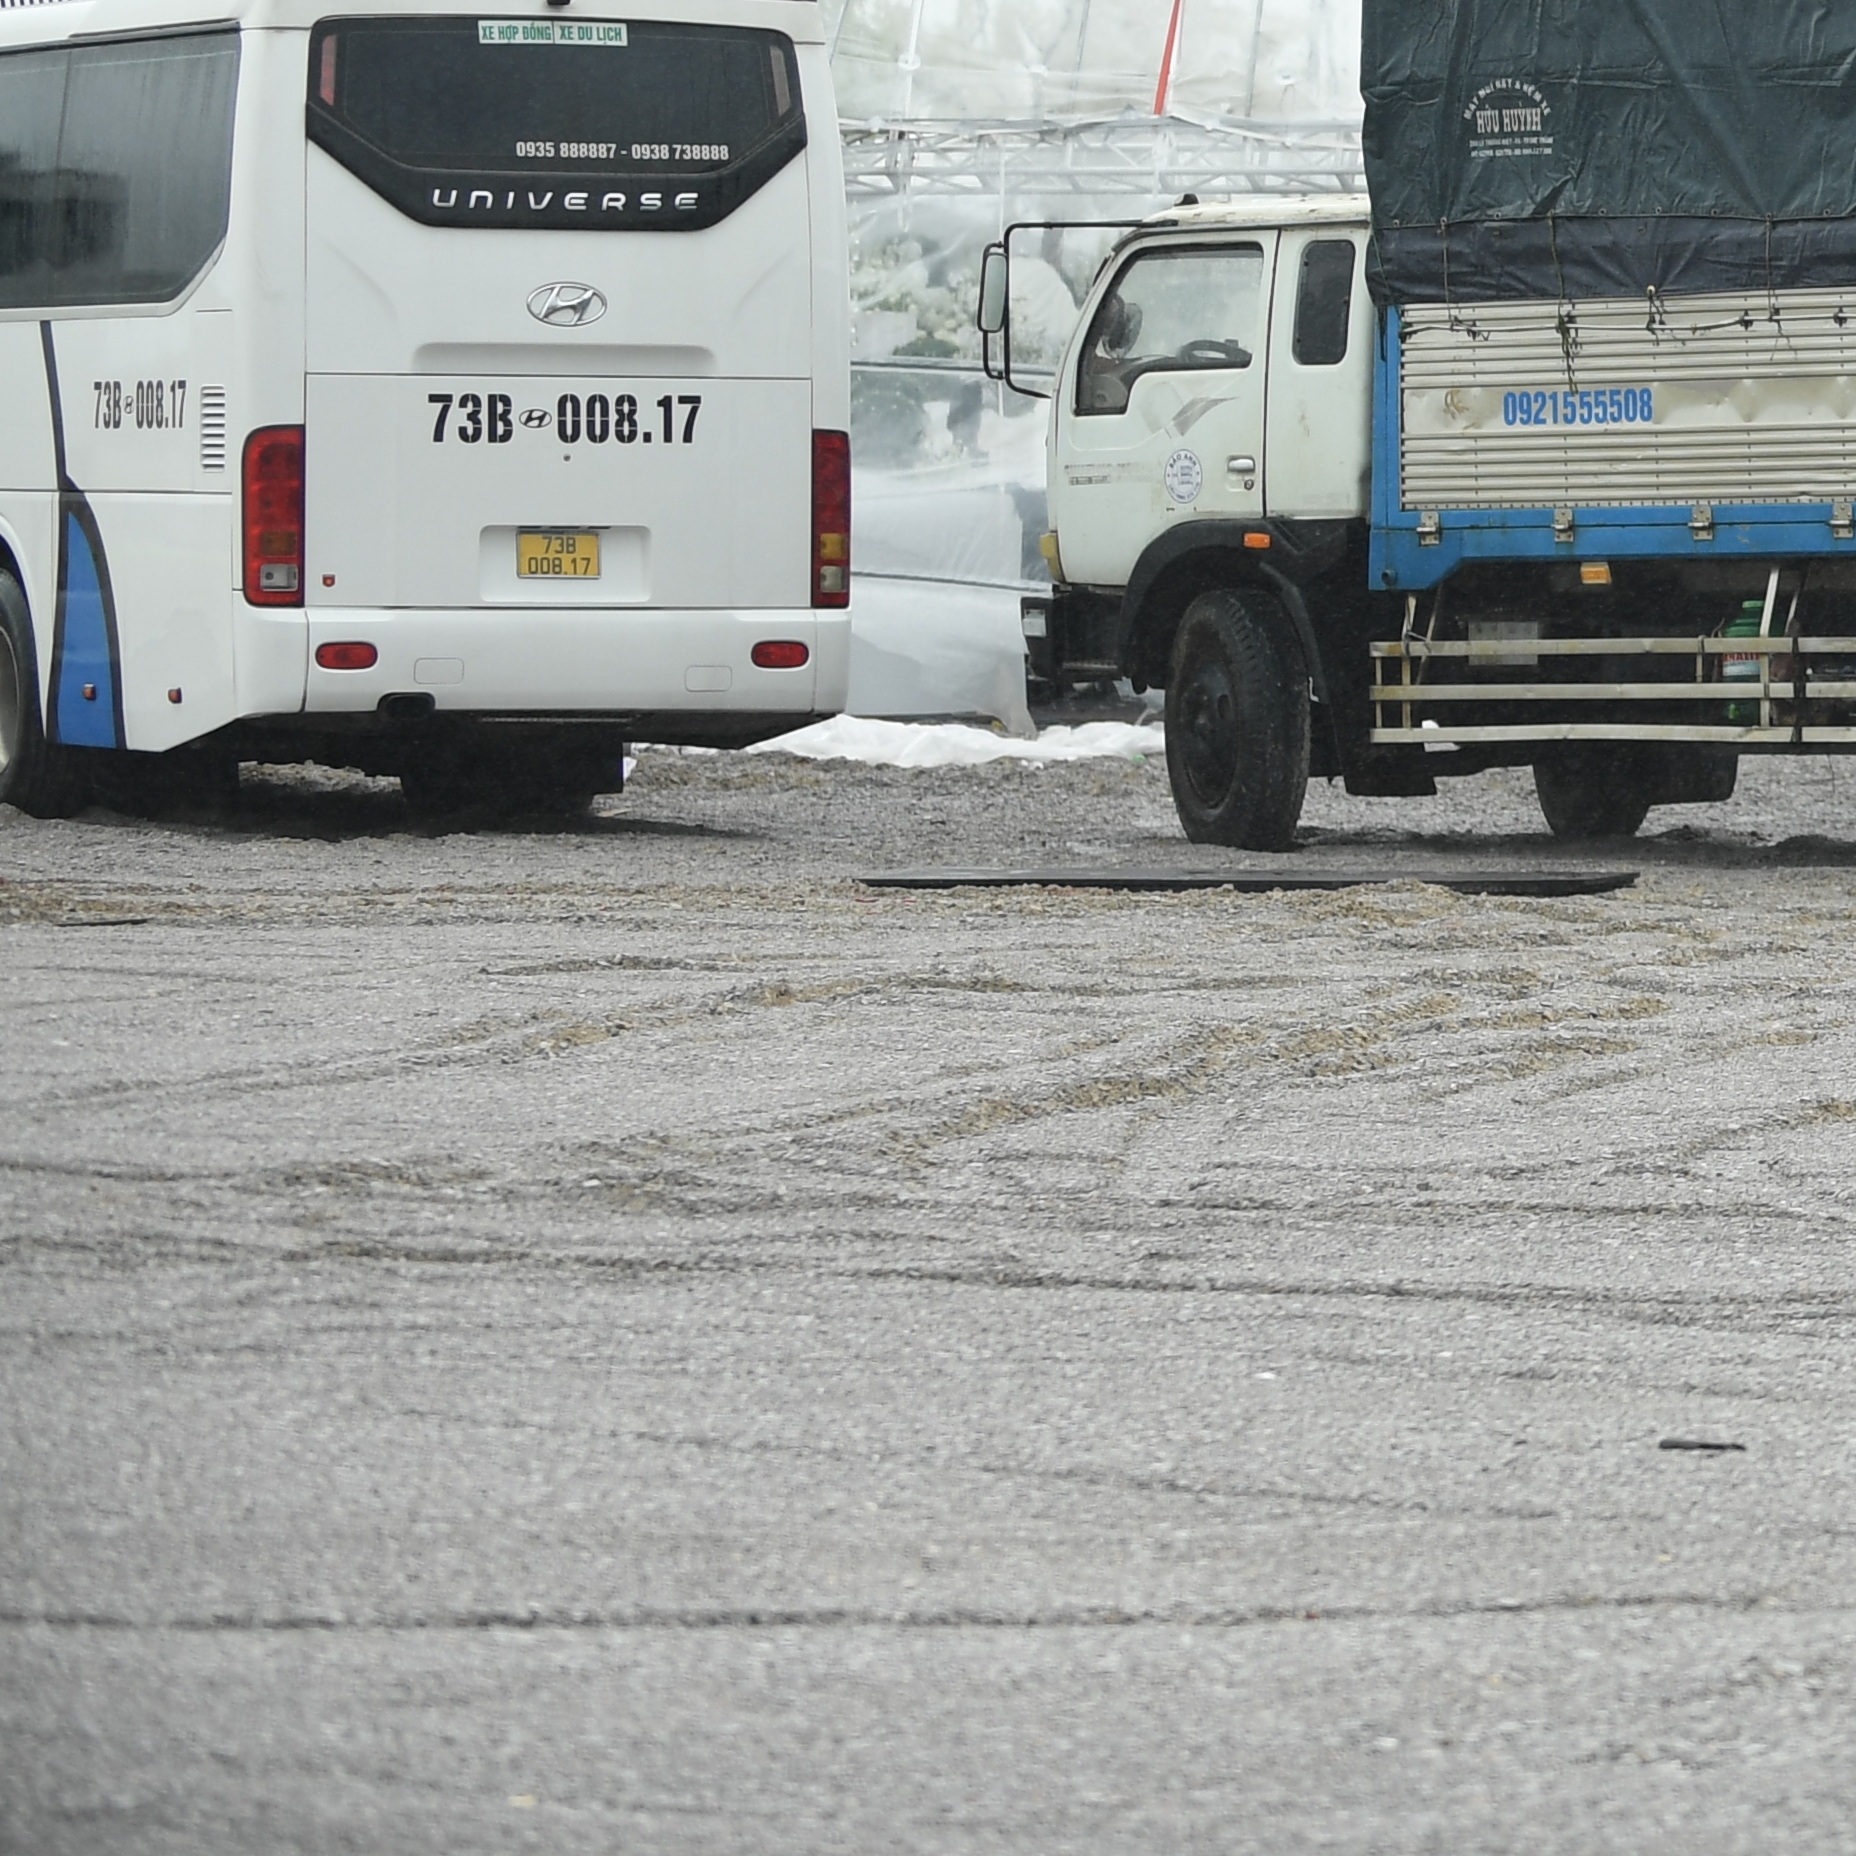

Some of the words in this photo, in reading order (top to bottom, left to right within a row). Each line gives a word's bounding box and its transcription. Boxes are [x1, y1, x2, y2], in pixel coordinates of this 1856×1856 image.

[481, 25, 494, 41] XE
[498, 24, 519, 43] HỢP
[559, 25, 574, 41] XE
[577, 25, 593, 41] DU
[596, 26, 622, 45] LỊCH
[516, 142, 555, 158] 0935
[559, 143, 617, 159] 888887
[631, 144, 669, 160] 0938
[672, 144, 730, 161] 738888
[431, 188, 699, 212] UNIVERSE
[93, 380, 122, 430] 73B
[136, 379, 187, 430] 008.17
[1503, 387, 1654, 426] 0921555508
[427, 392, 514, 444] 73B
[557, 393, 702, 444] 008.17
[541, 535, 577, 555] 73B
[527, 556, 592, 576] 008.17
